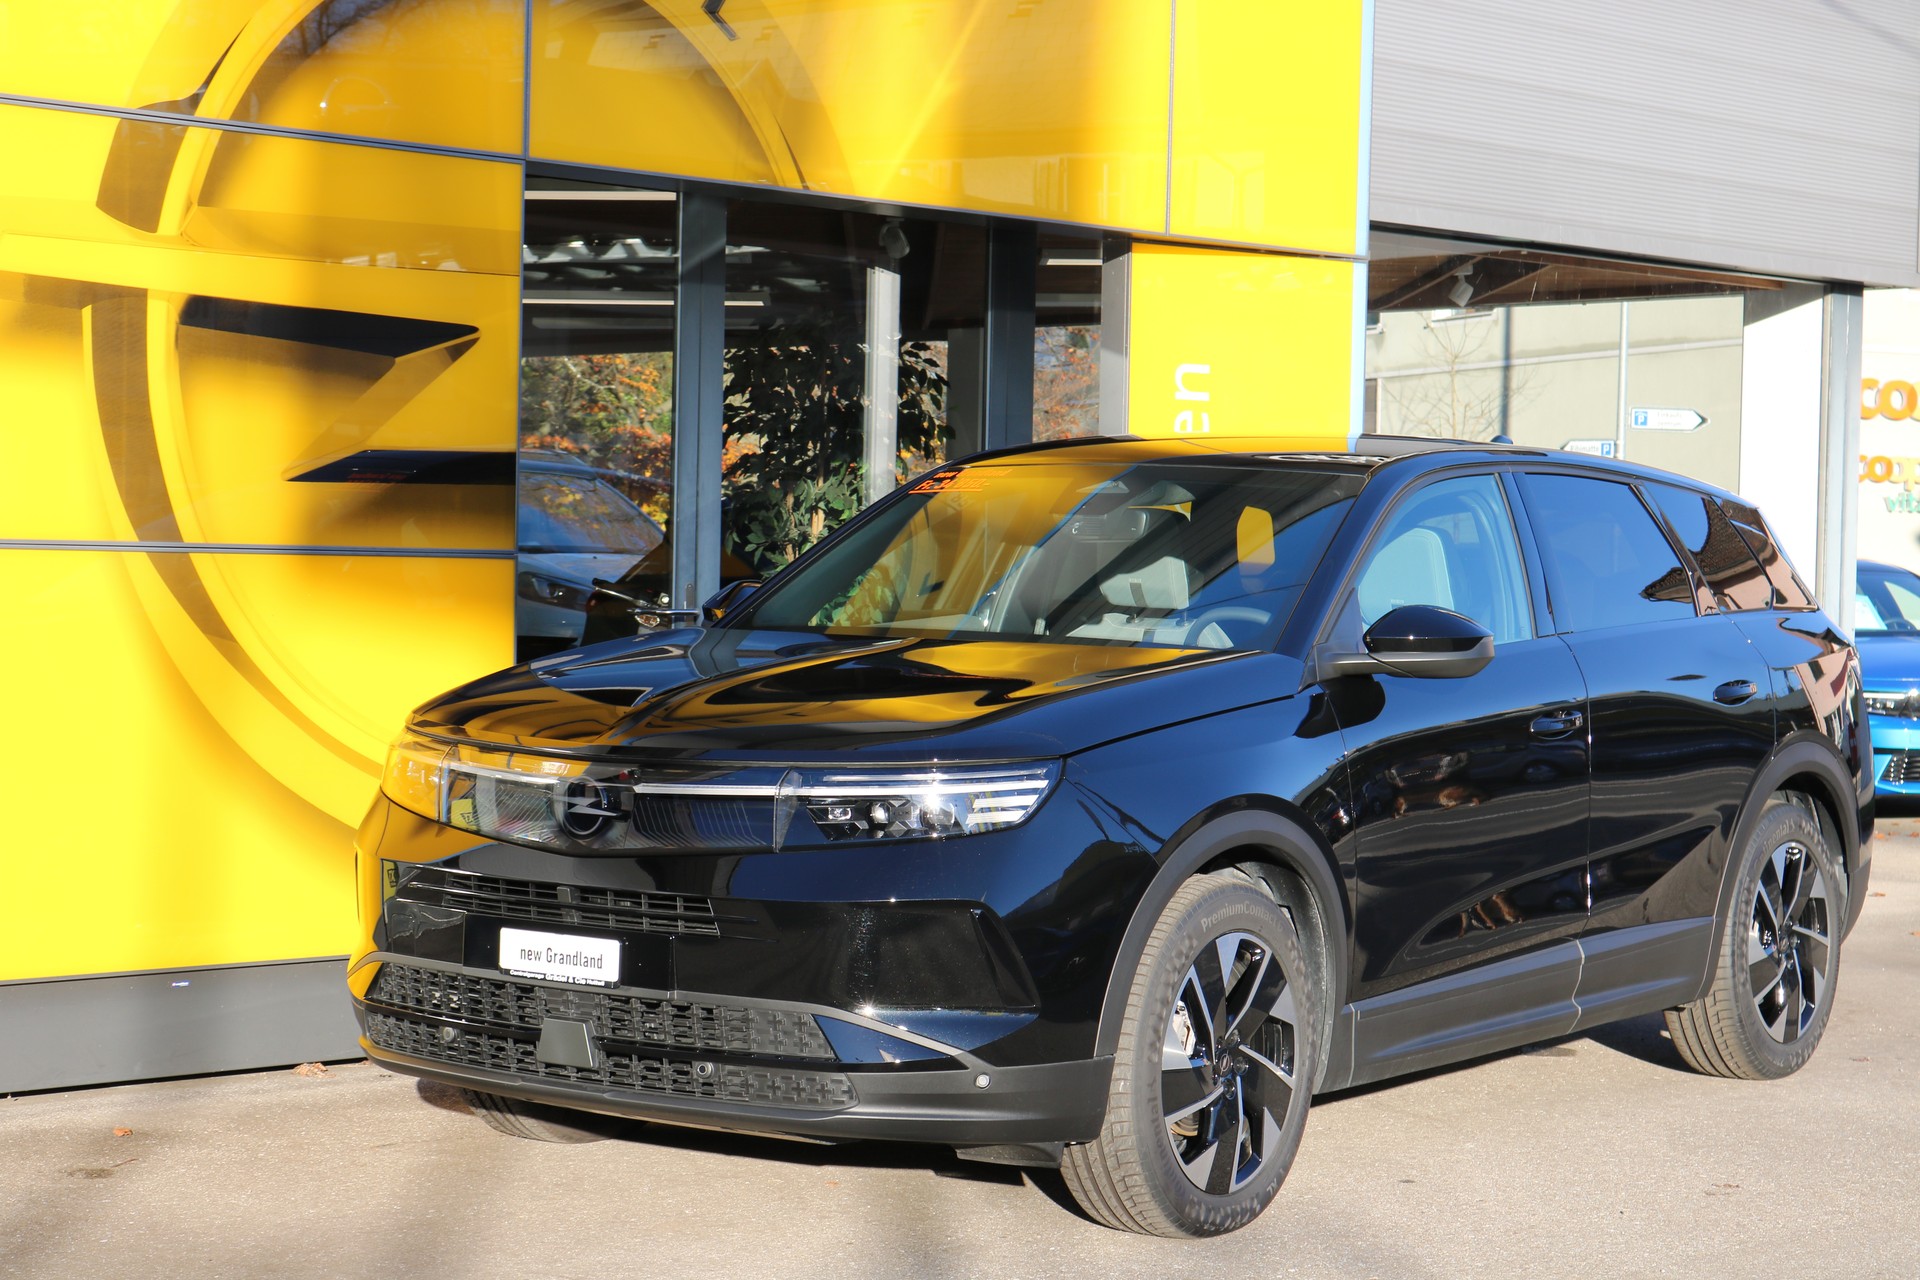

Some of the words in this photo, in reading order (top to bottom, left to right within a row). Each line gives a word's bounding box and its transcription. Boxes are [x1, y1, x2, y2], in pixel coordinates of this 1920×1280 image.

[1200, 901, 1278, 933] PremiumContact
[520, 947, 542, 962] new
[546, 947, 603, 969] Grandland
